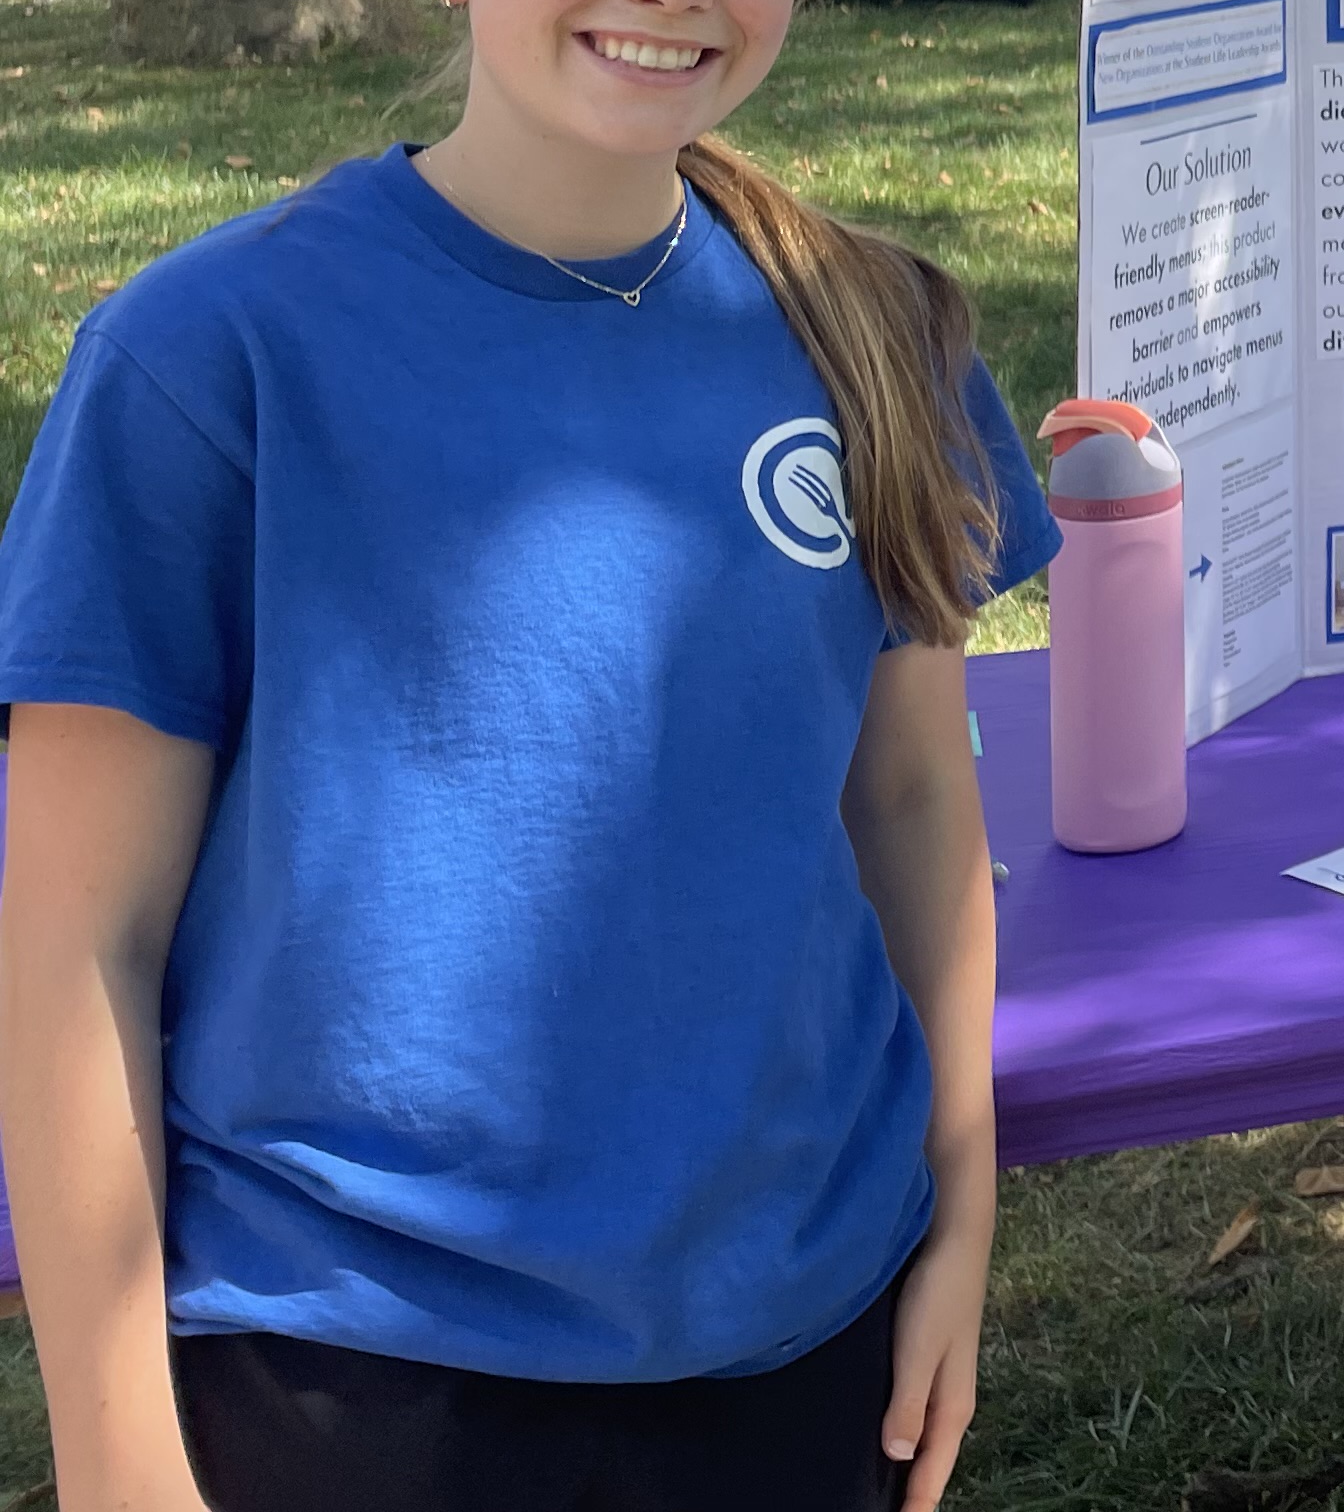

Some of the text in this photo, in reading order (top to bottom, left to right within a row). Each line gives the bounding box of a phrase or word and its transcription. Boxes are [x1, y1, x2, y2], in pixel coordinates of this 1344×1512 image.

[1146, 144, 1252, 196] Our Solution
[1122, 185, 1270, 246] We create screen-reader-
[1114, 252, 1166, 289] friendly
[1209, 232, 1229, 254] this
[1233, 220, 1276, 257] product
[1109, 253, 1281, 331] removes a major accessibility
[1132, 300, 1262, 363] barrier and empowers
[1178, 364, 1189, 384] to
[1193, 344, 1242, 378] navigate
[1246, 329, 1283, 357] menus
